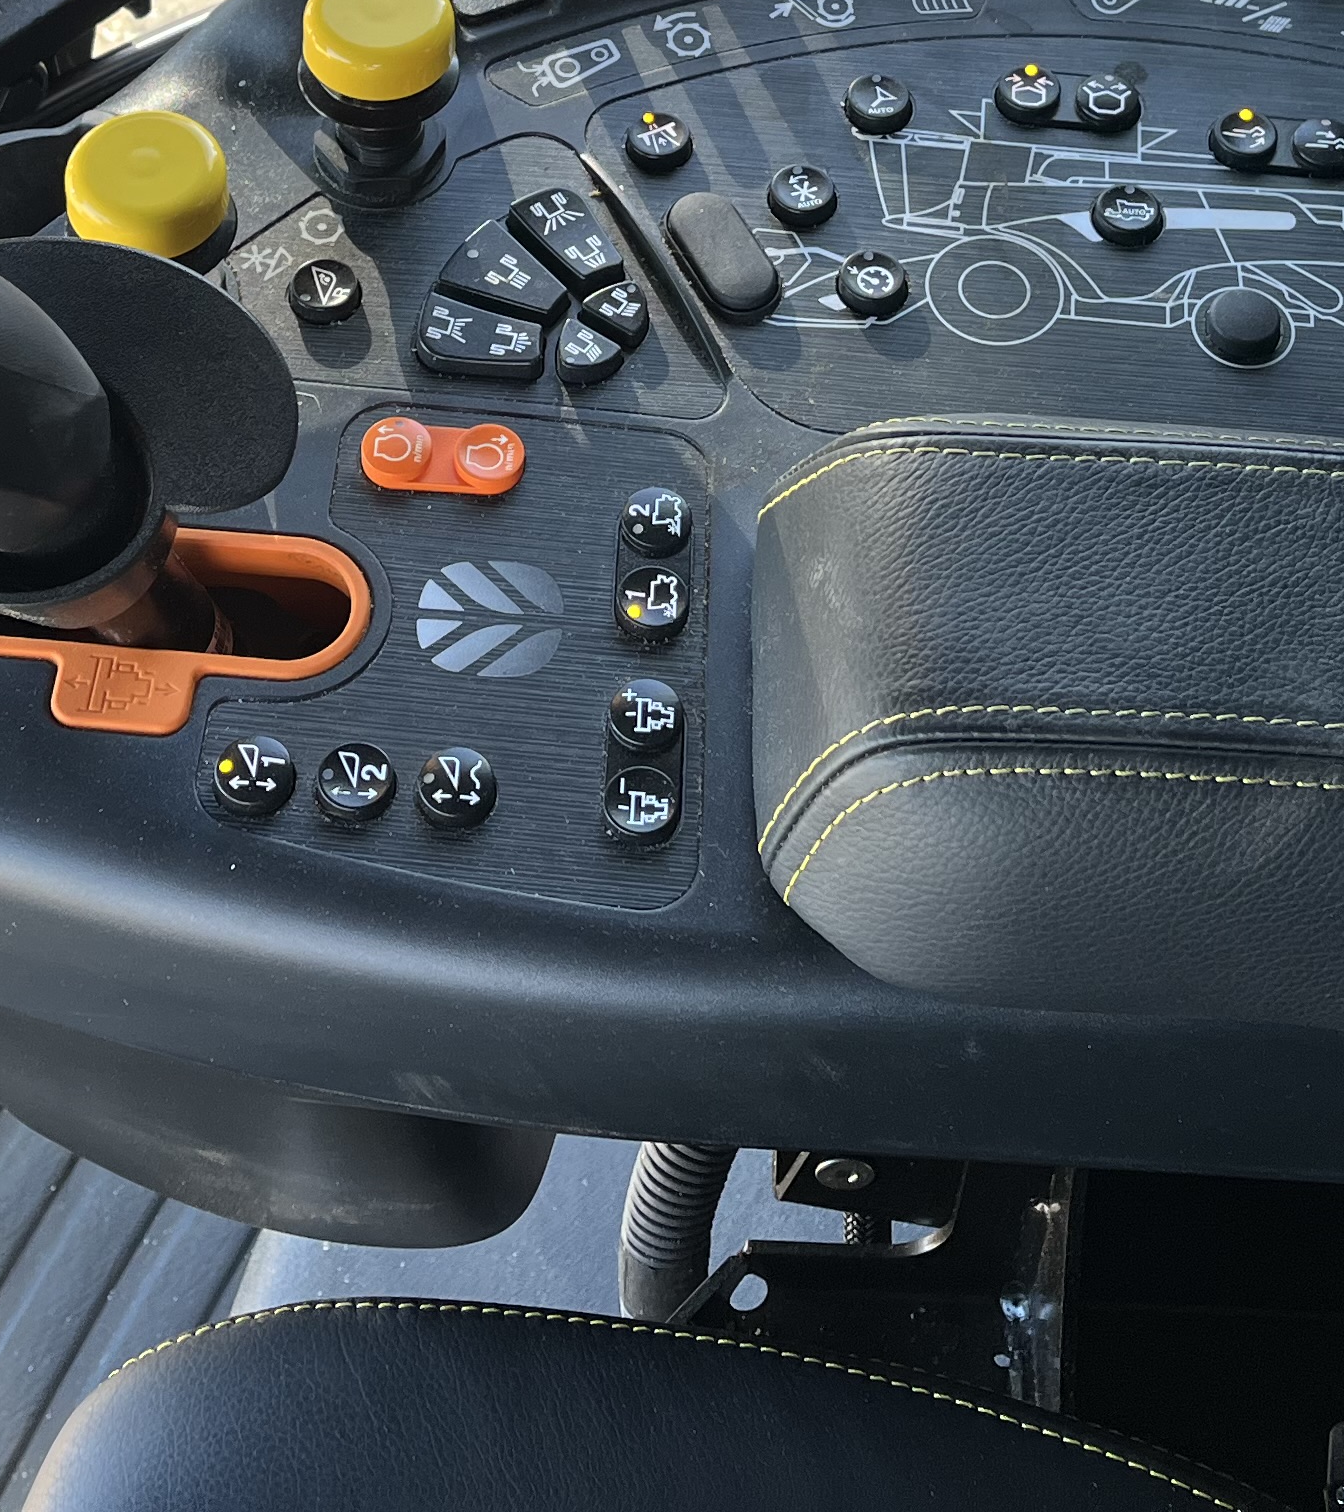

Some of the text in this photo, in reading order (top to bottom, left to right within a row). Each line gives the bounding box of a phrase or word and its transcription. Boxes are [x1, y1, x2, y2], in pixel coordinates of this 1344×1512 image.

[868, 106, 894, 114] AUTO
[797, 198, 823, 209] AUTO
[413, 434, 424, 463] n/min
[506, 442, 516, 471] n/min
[628, 503, 650, 517] 2
[624, 590, 646, 600] 1
[260, 755, 286, 767] 1
[360, 763, 388, 781] 2
